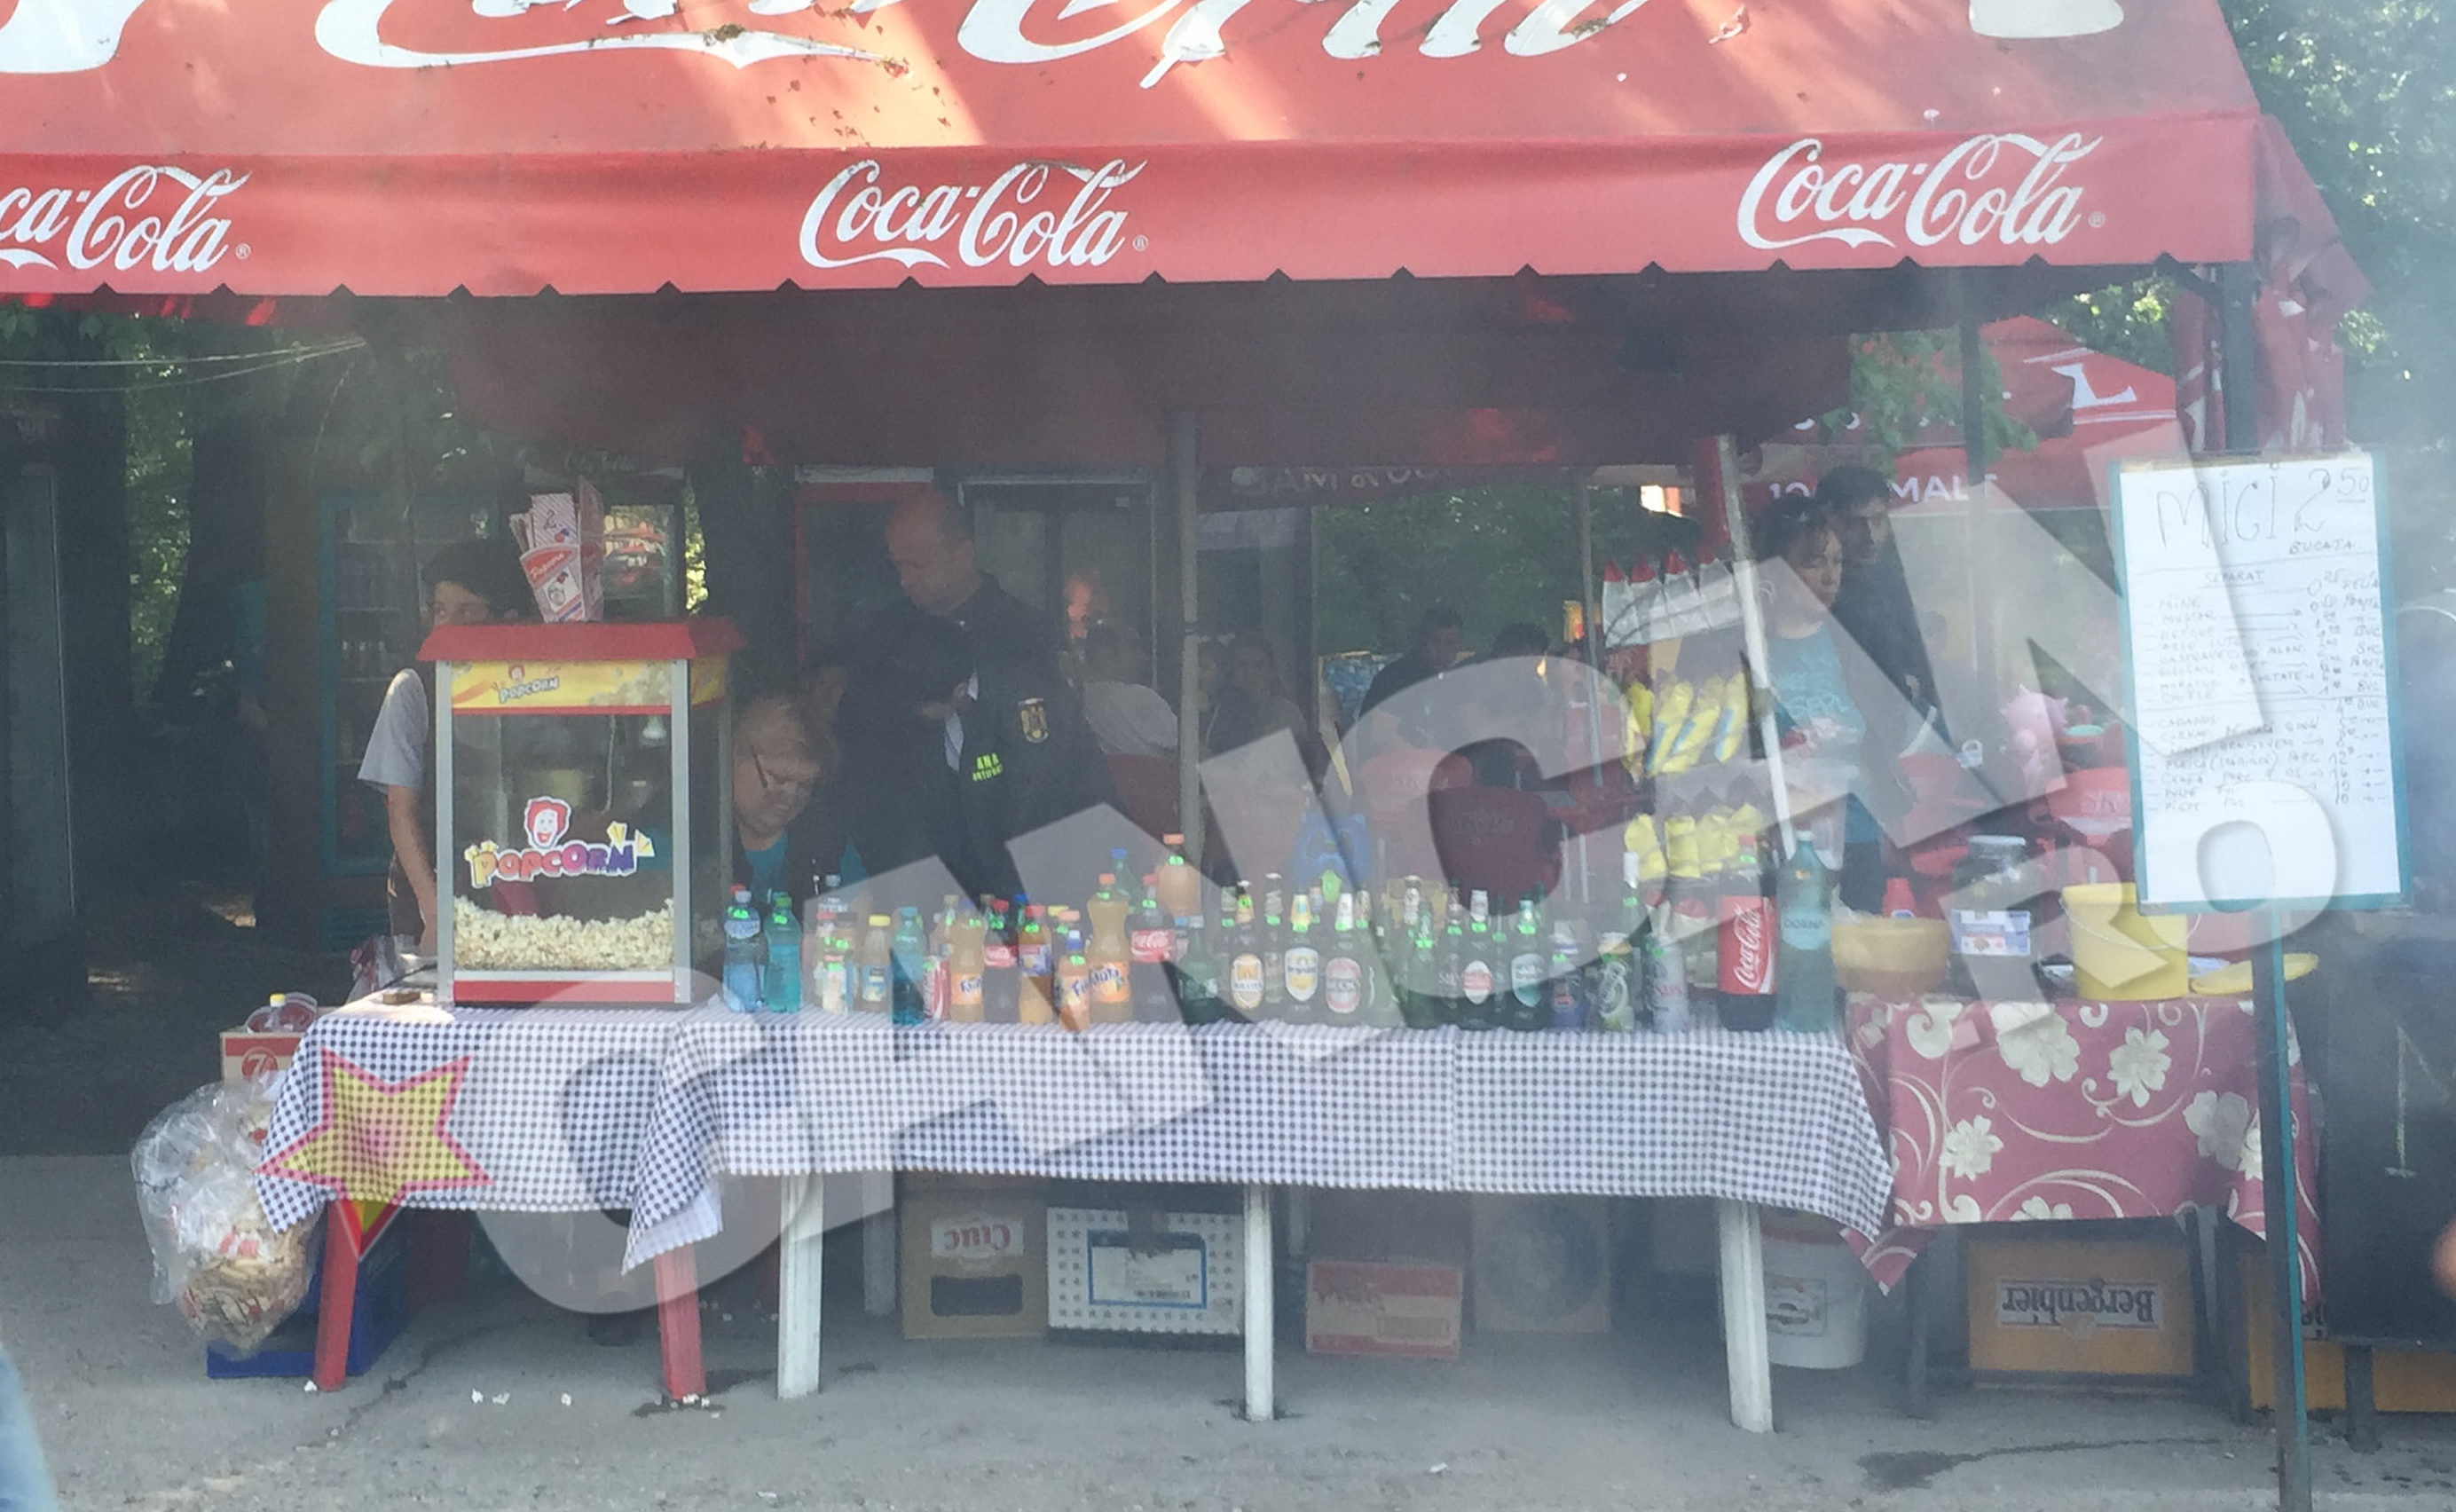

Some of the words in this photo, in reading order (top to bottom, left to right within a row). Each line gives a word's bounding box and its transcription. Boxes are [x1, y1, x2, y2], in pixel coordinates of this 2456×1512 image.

[0, 165, 252, 272] ca-Cola
[799, 159, 1148, 270] Coca-Cola
[1736, 132, 2103, 249] Coca-Cola
[1733, 902, 1761, 988] Coca-Cola
[2002, 1278, 2156, 1325] Bergenbier
